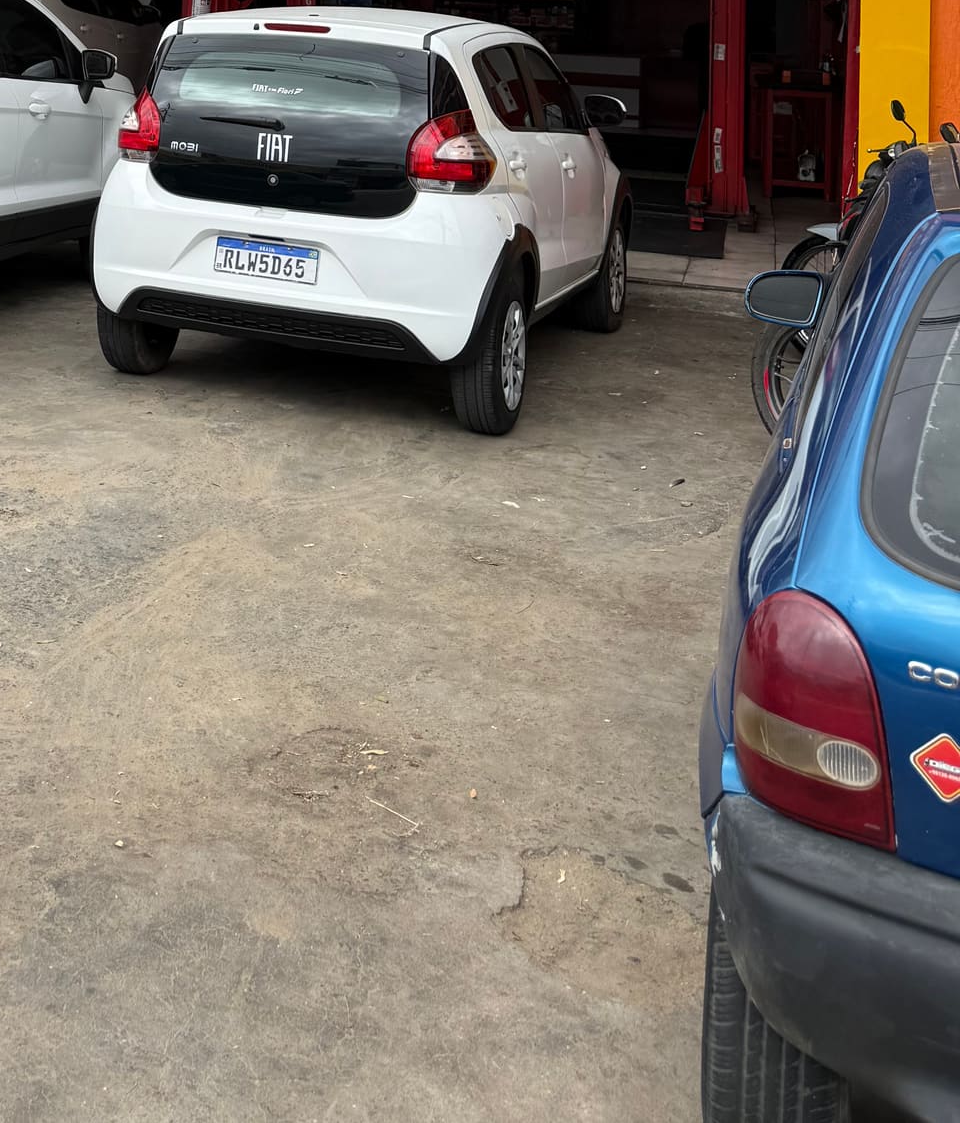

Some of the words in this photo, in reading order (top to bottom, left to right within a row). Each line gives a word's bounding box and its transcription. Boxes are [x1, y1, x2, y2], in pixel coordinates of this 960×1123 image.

[170, 140, 199, 153] MOBI
[256, 132, 293, 163] FIAT
[222, 249, 306, 279] RLW5D65
